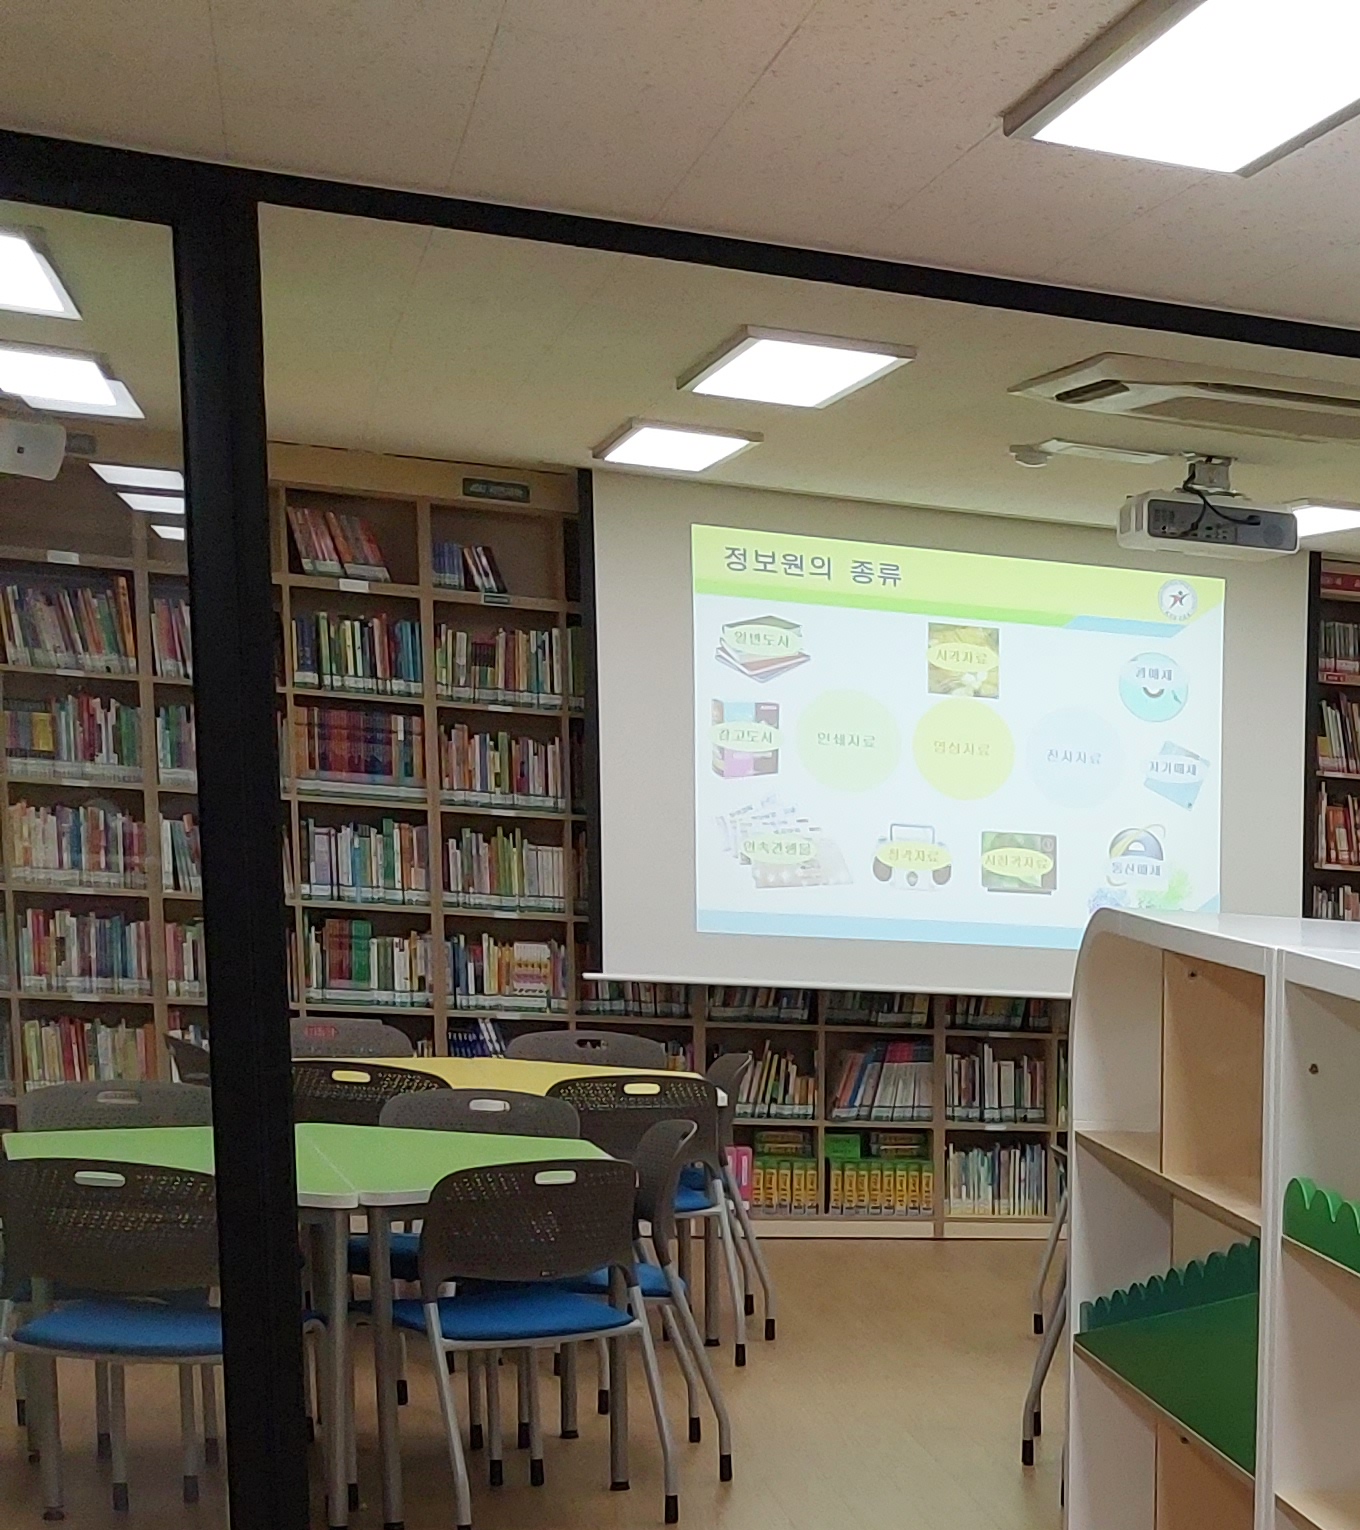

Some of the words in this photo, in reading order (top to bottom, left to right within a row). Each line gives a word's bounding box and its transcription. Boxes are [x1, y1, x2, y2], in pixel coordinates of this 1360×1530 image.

[724, 546, 832, 580] 정보원의
[850, 559, 902, 588] 종류
[936, 648, 988, 666] 시각자료
[817, 731, 877, 748] 인쇄자료
